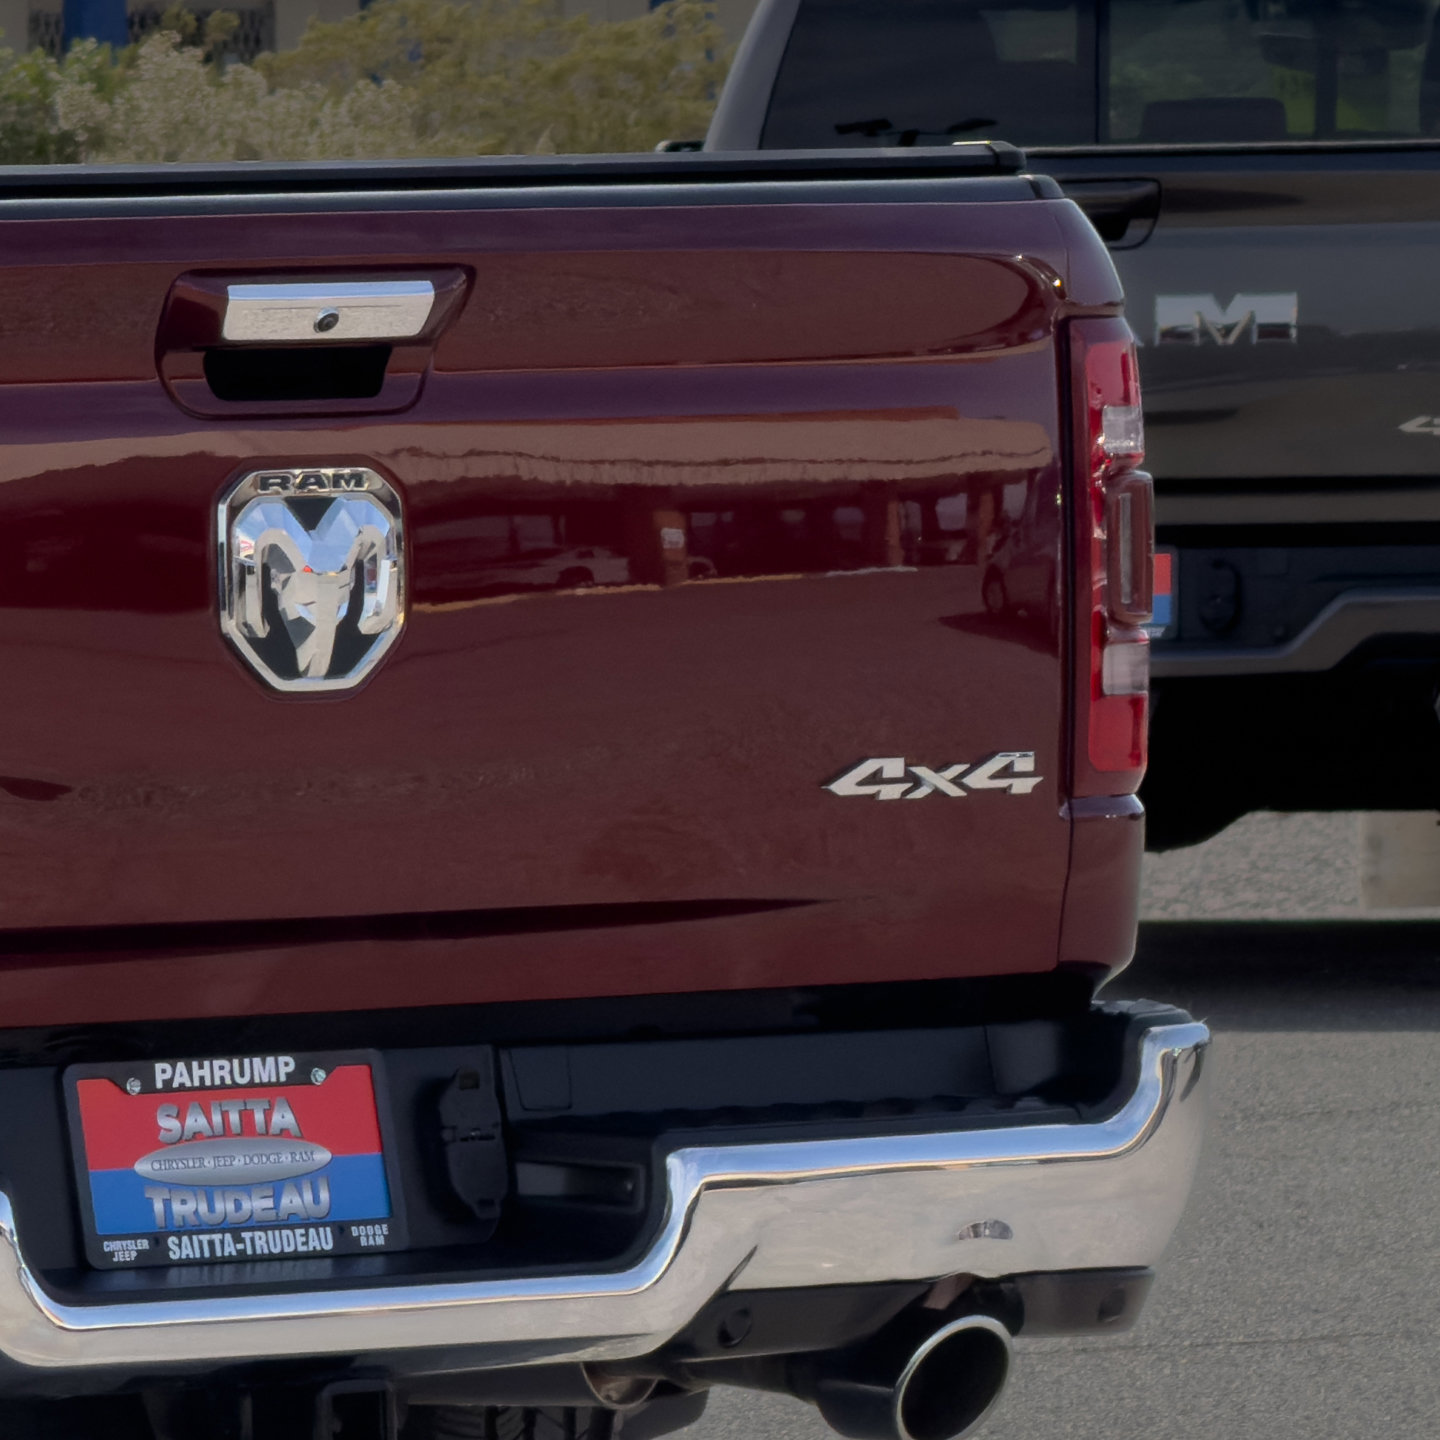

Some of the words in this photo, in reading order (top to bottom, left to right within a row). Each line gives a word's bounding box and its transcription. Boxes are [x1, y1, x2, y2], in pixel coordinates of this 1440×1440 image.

[257, 472, 369, 493] RAM
[822, 750, 1044, 801] 4x4
[154, 1055, 297, 1090] PAHRUMP
[156, 1096, 303, 1145] SAITTA
[150, 1157, 206, 1172] CHRYSLER
[212, 1155, 236, 1170] JEEP
[243, 1152, 283, 1167] DODGE
[289, 1150, 316, 1164] RAM
[144, 1175, 331, 1230] TRUDEAU
[351, 1223, 389, 1238] DODGE
[359, 1234, 386, 1248] RAM
[102, 1238, 150, 1254] CHRYSLER
[167, 1226, 334, 1261] SAITTA-TRUDEAU
[112, 1250, 138, 1262] JEEP
